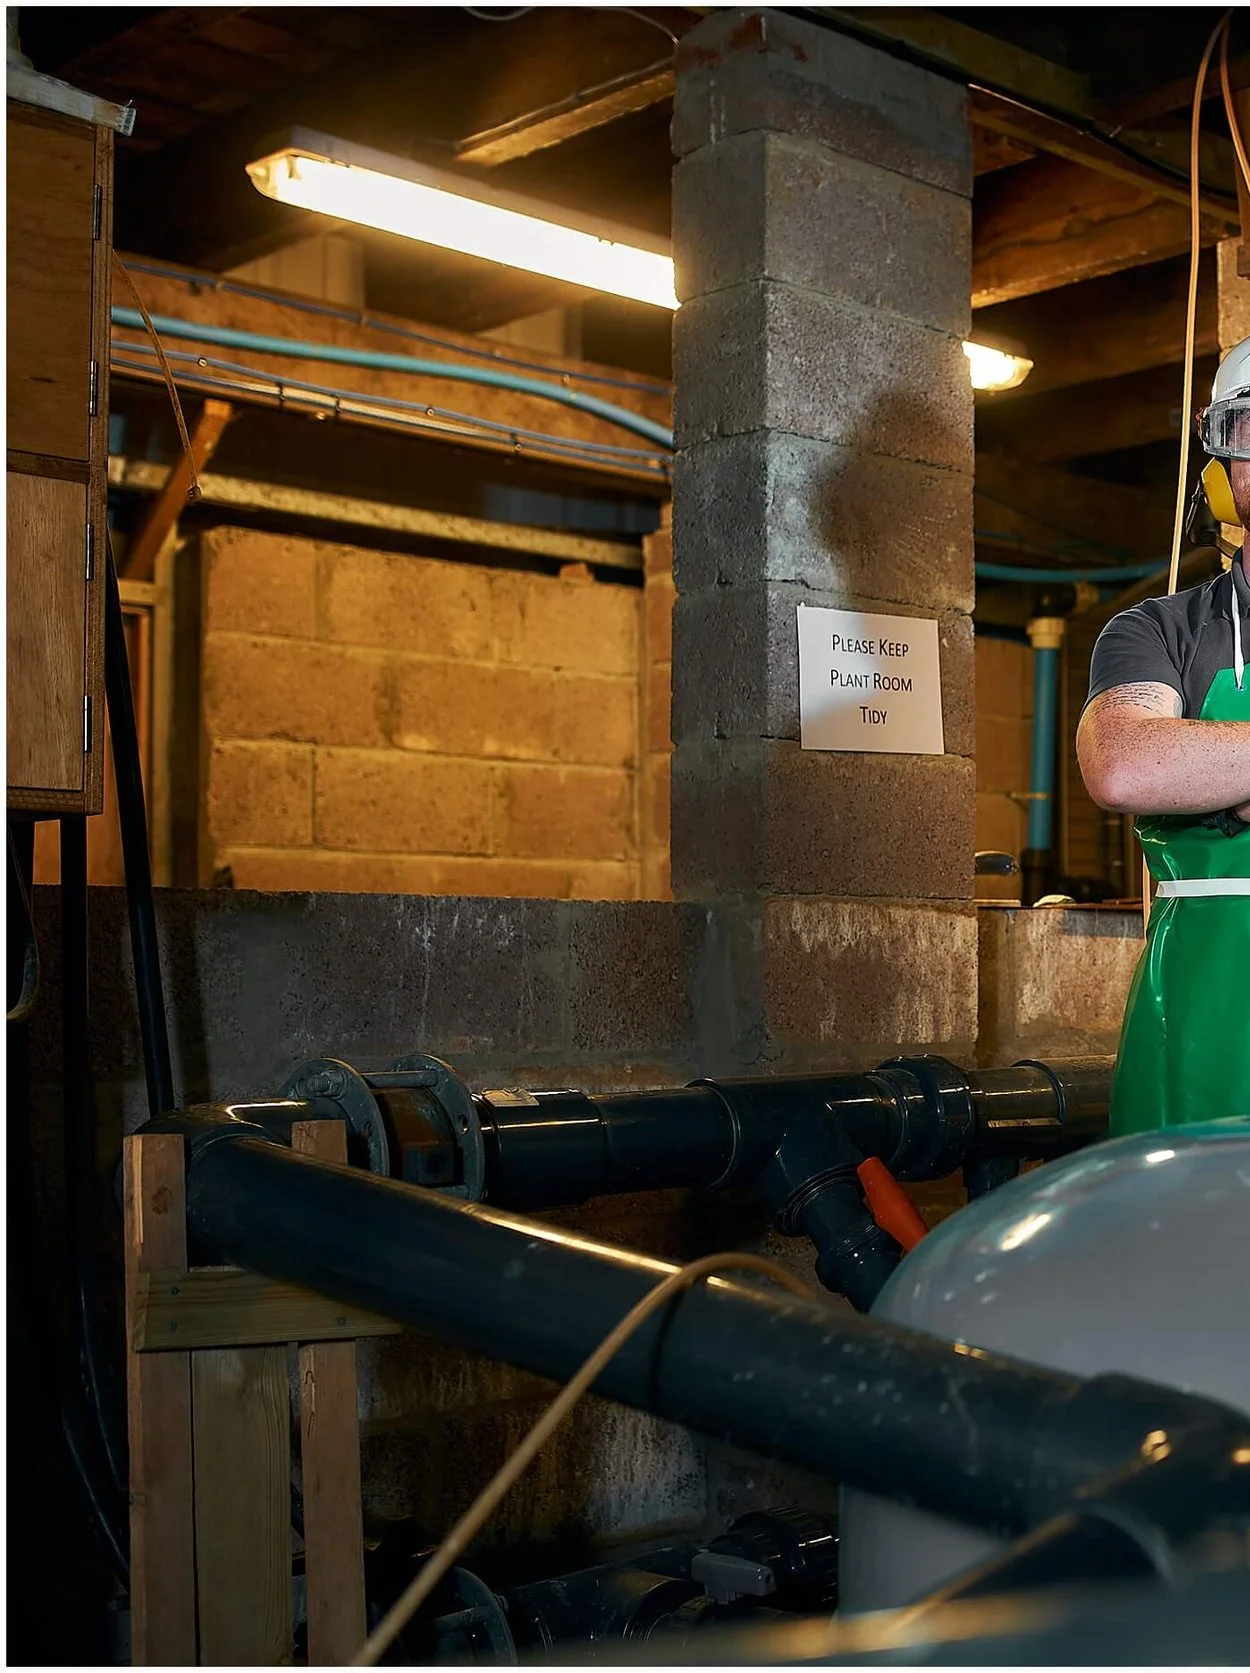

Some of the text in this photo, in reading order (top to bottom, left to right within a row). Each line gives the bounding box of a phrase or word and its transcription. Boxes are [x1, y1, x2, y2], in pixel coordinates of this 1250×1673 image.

[832, 634, 909, 657] PLEASE KEEP
[830, 669, 912, 692] PLANT ROOM
[859, 706, 888, 724] TIDY
